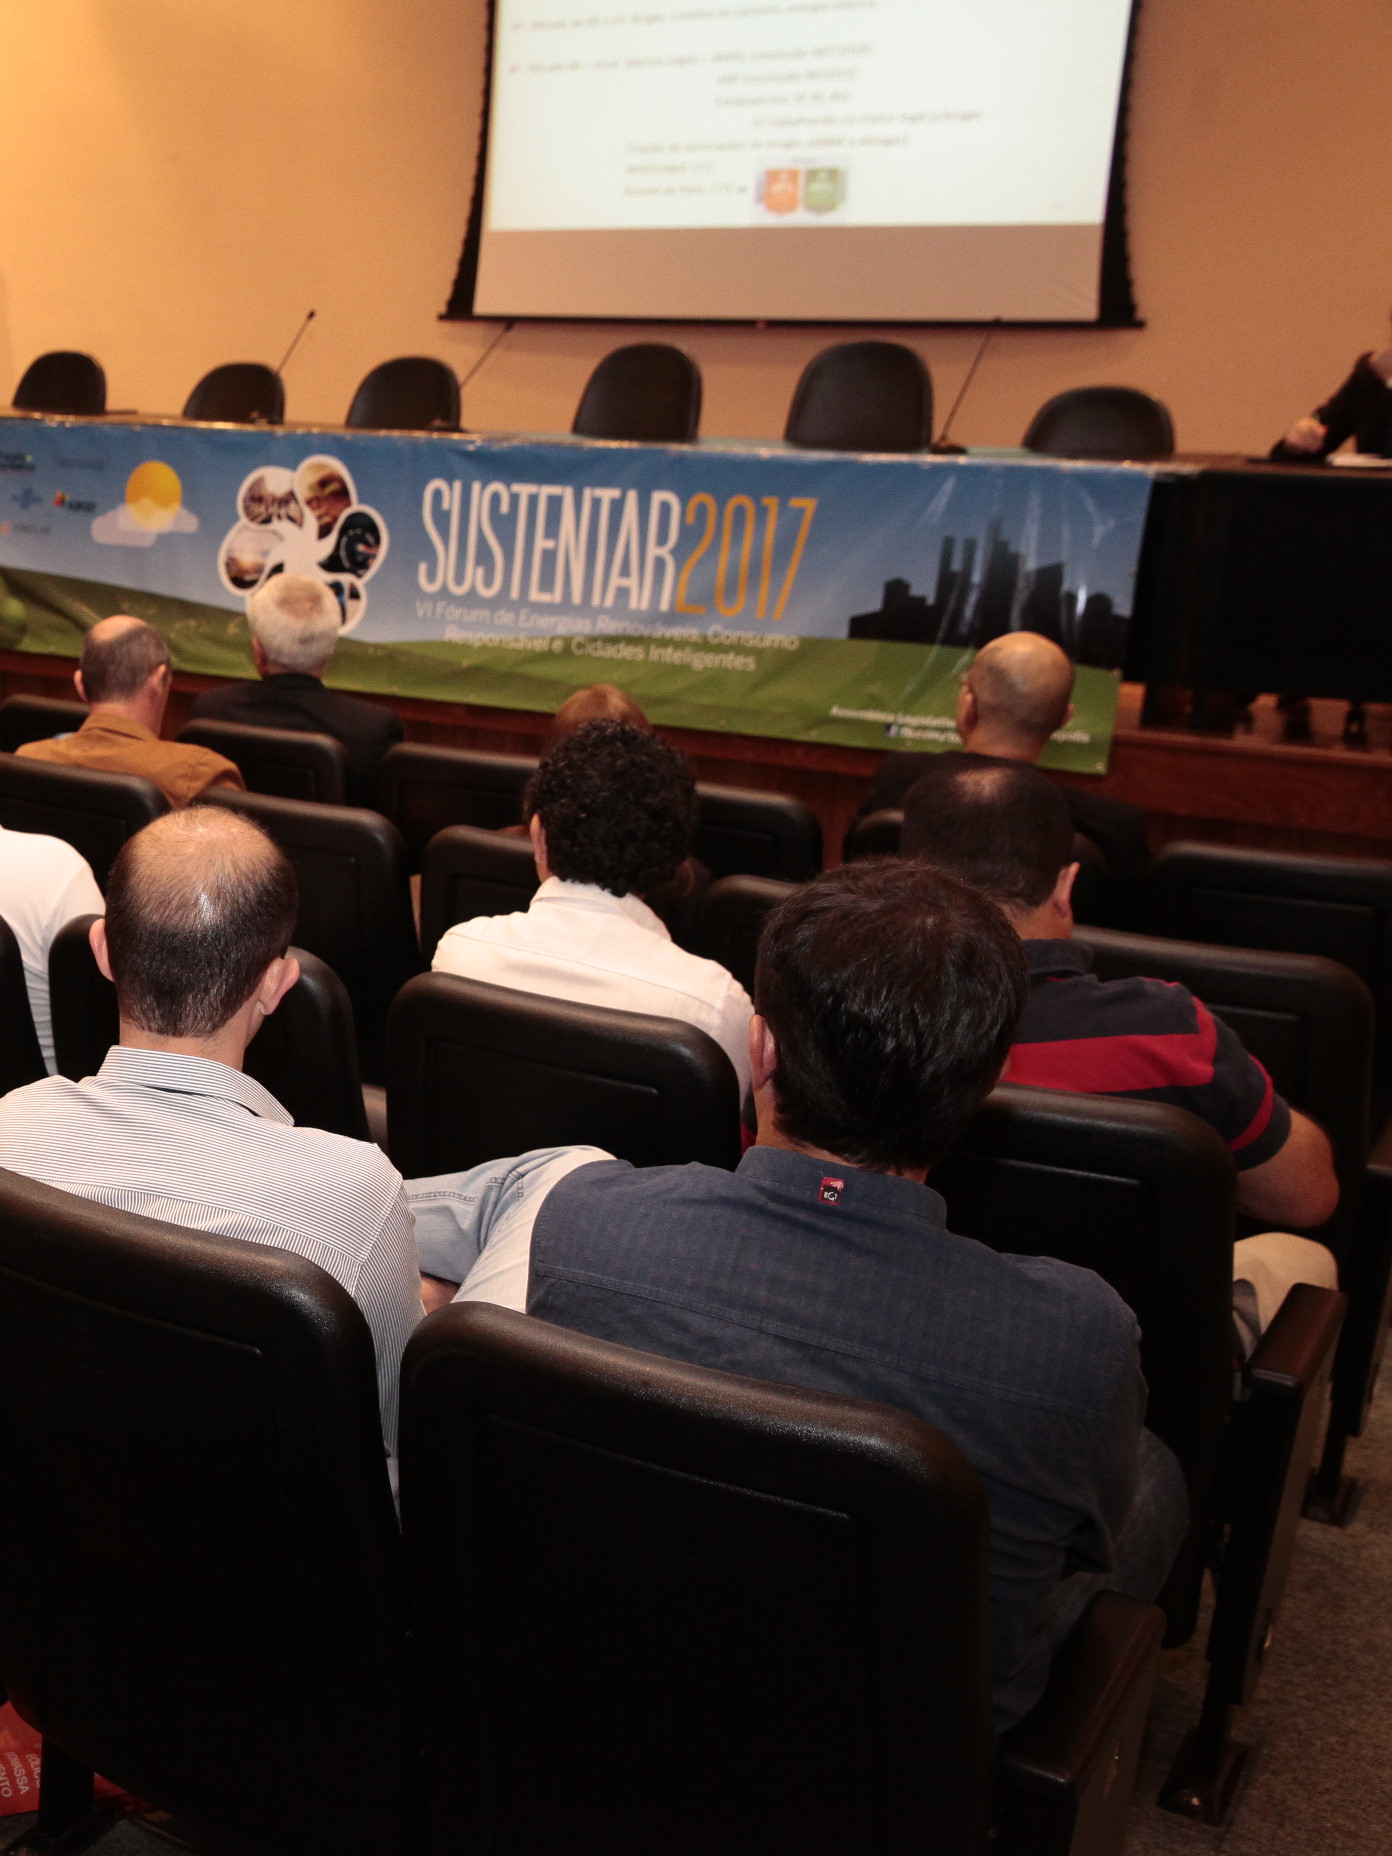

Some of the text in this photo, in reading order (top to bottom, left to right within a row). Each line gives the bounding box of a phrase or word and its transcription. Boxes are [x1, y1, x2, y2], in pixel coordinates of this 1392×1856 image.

[435, 600, 492, 623] Fórum
[493, 609, 517, 626] de
[518, 608, 592, 635] Energias
[707, 624, 801, 651] Consumo
[550, 637, 564, 654] e
[570, 634, 646, 662] Cidades
[648, 643, 757, 671] Inteligentes
